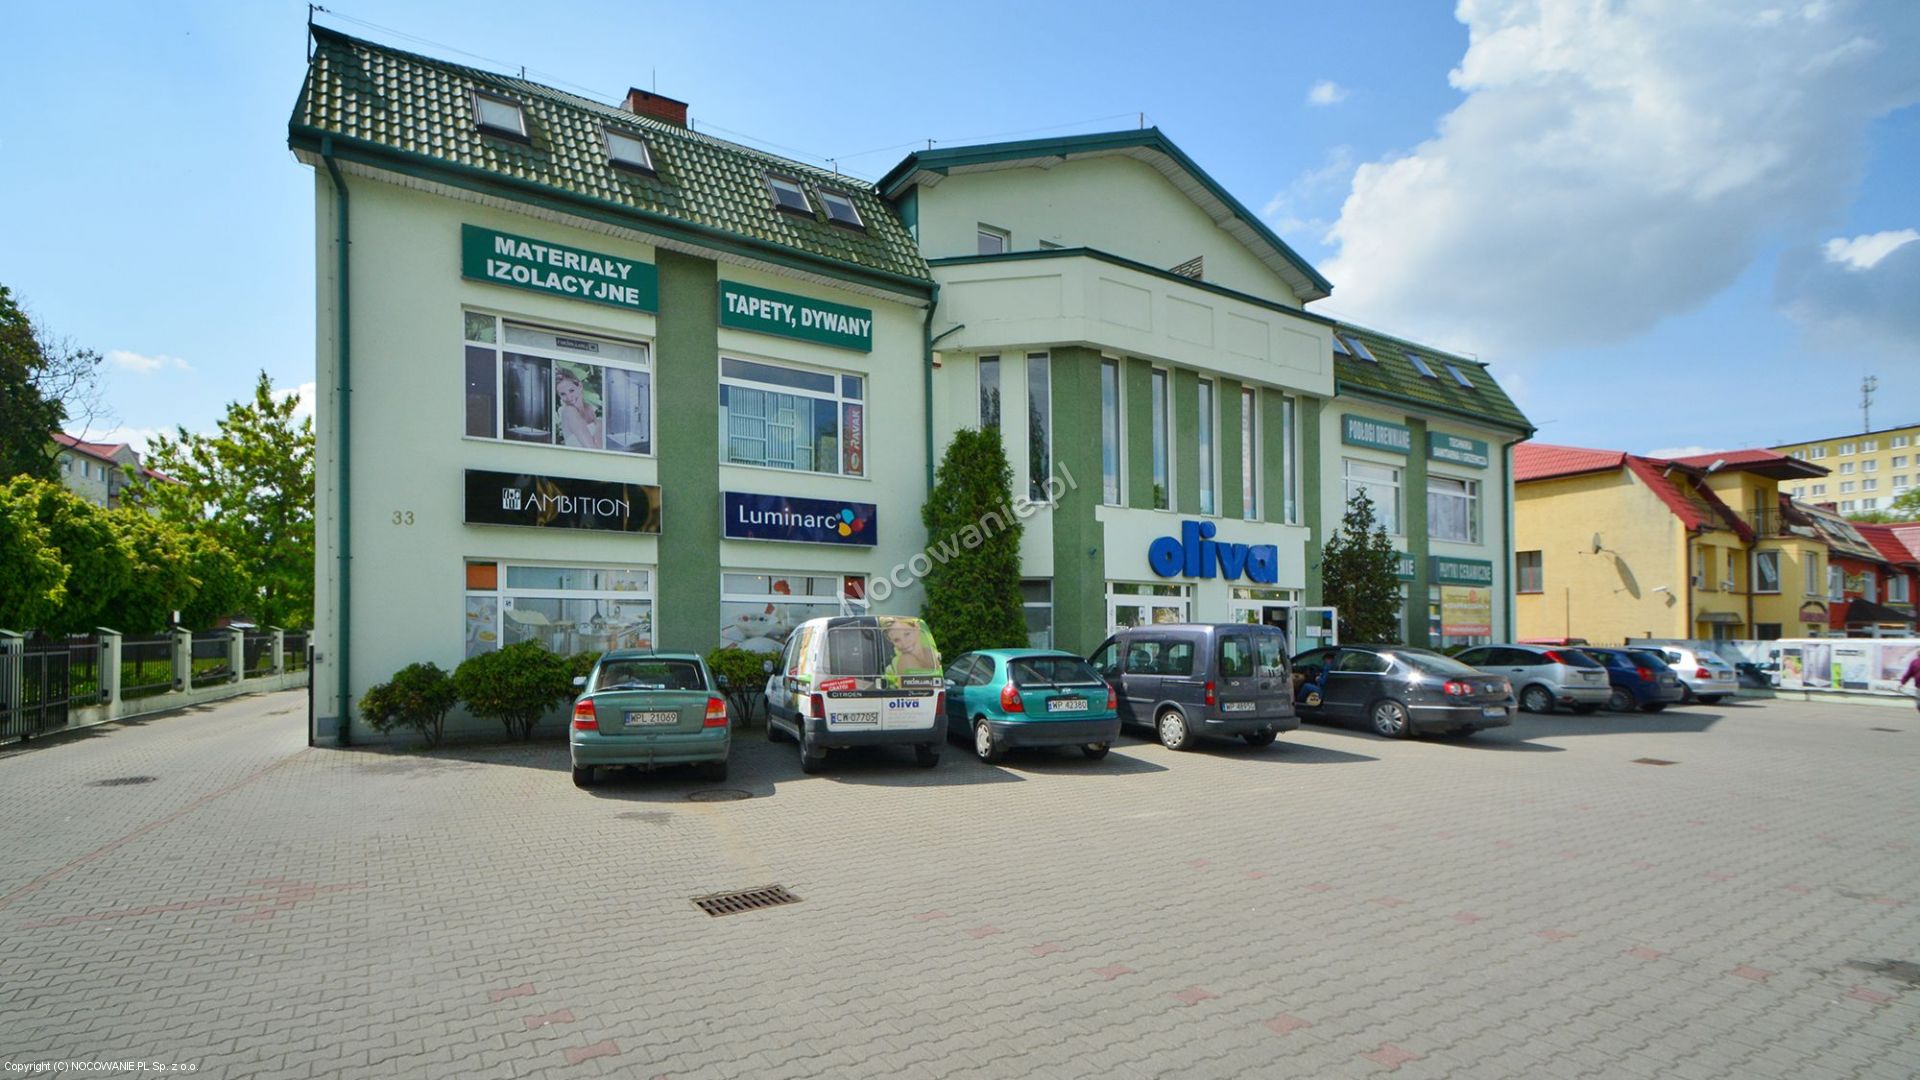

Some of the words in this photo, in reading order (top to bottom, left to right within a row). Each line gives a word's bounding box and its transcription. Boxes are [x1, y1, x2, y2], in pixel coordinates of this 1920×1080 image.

[494, 236, 632, 280] MATERIAŁY
[487, 259, 640, 305] IZOLACYJNE
[725, 292, 796, 328] TAPETY,
[801, 308, 871, 337] DYWANY
[392, 511, 415, 525] 33
[524, 493, 630, 518] AMBITION
[740, 504, 837, 529] Luminarc
[1148, 520, 1278, 584] oliva
[889, 698, 920, 709] oliva
[1052, 701, 1063, 710] WP
[1065, 700, 1087, 710] 42380
[631, 713, 646, 723] WPL
[650, 712, 676, 723] 21069
